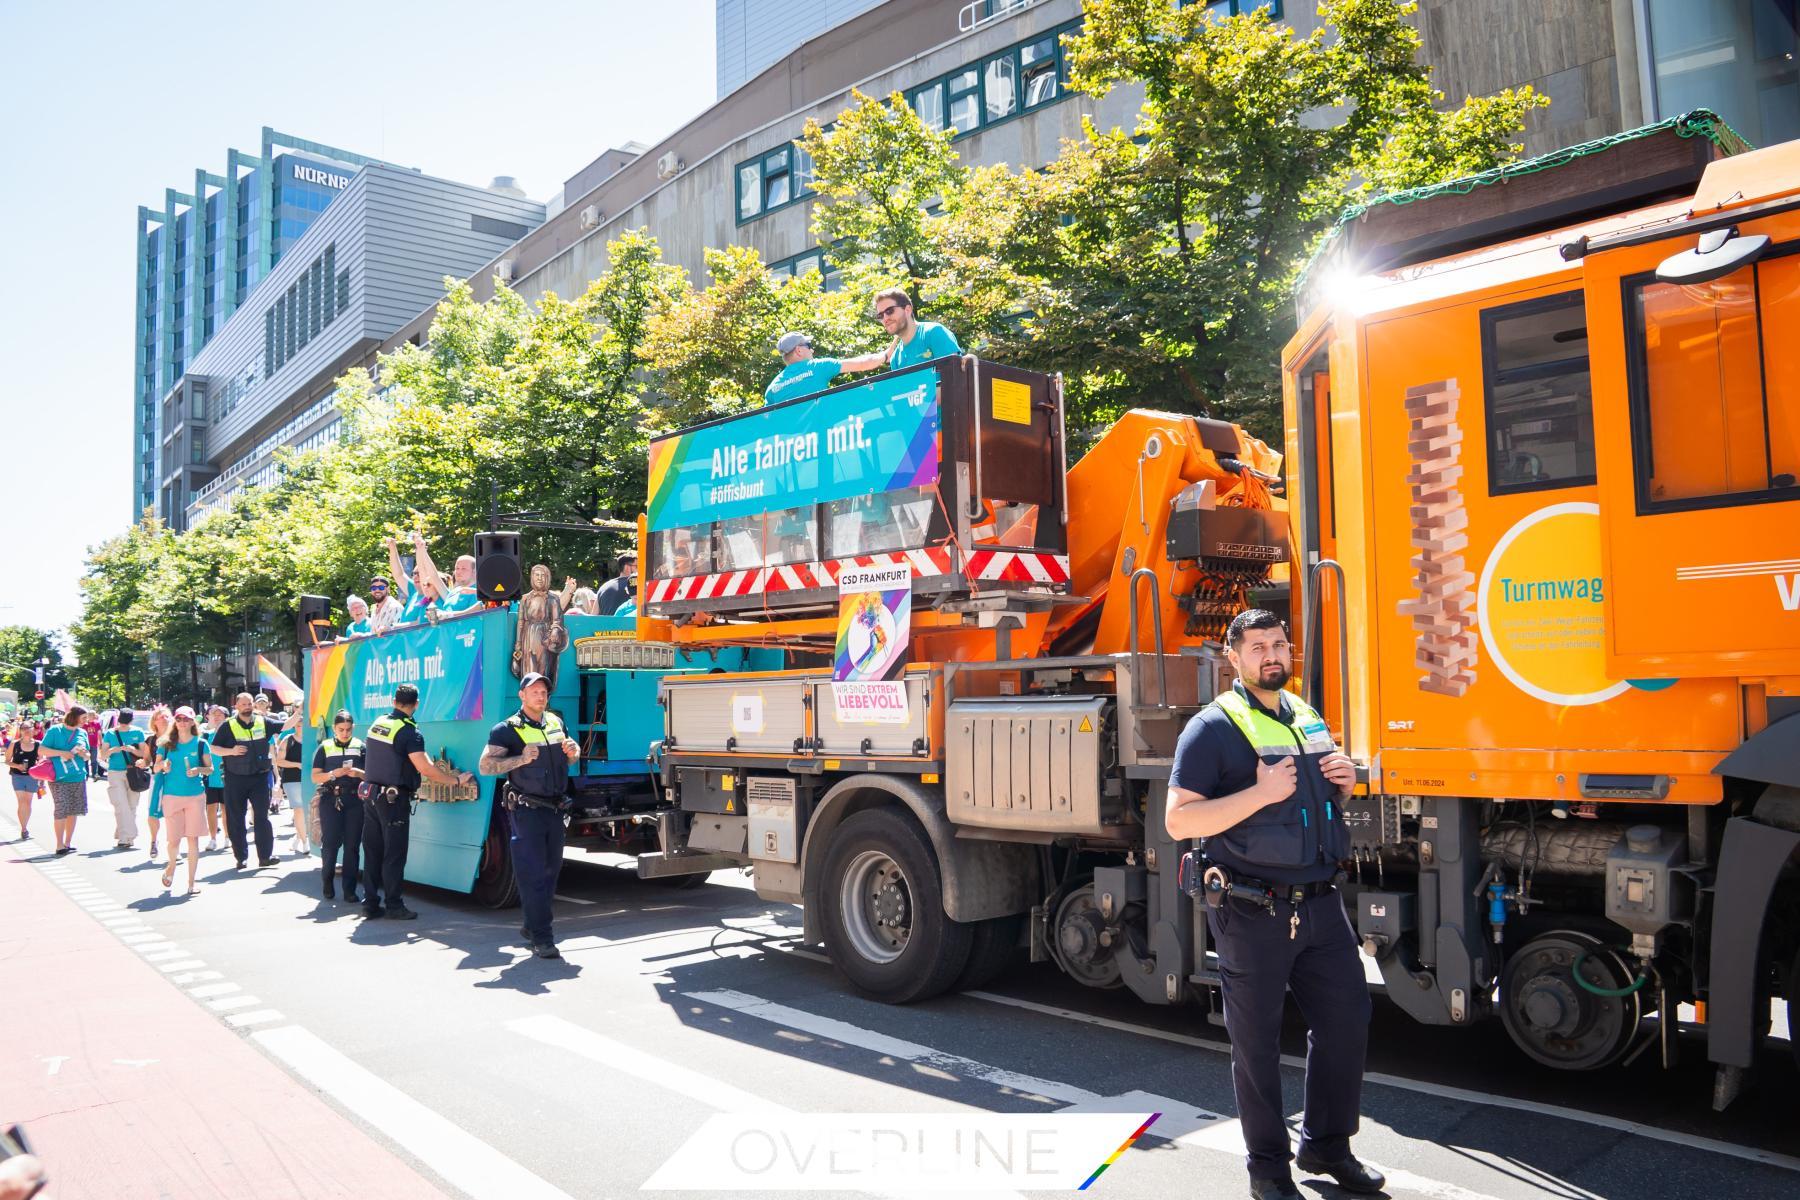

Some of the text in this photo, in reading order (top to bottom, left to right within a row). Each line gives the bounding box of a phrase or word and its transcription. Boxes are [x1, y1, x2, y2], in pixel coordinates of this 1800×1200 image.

[294, 165, 351, 190] NÜRNB
[710, 414, 872, 480] Alle fahren mit.
[710, 480, 764, 505] #öffisbunt
[842, 569, 907, 585] CSD FRANKFURT
[1500, 577, 1604, 603] Turmwag
[365, 646, 445, 687] Alle fahren mit.
[836, 685, 898, 694] WIR SIND EXTREM
[838, 695, 904, 709] LIEBEVOLL
[1387, 720, 1415, 730] SRT
